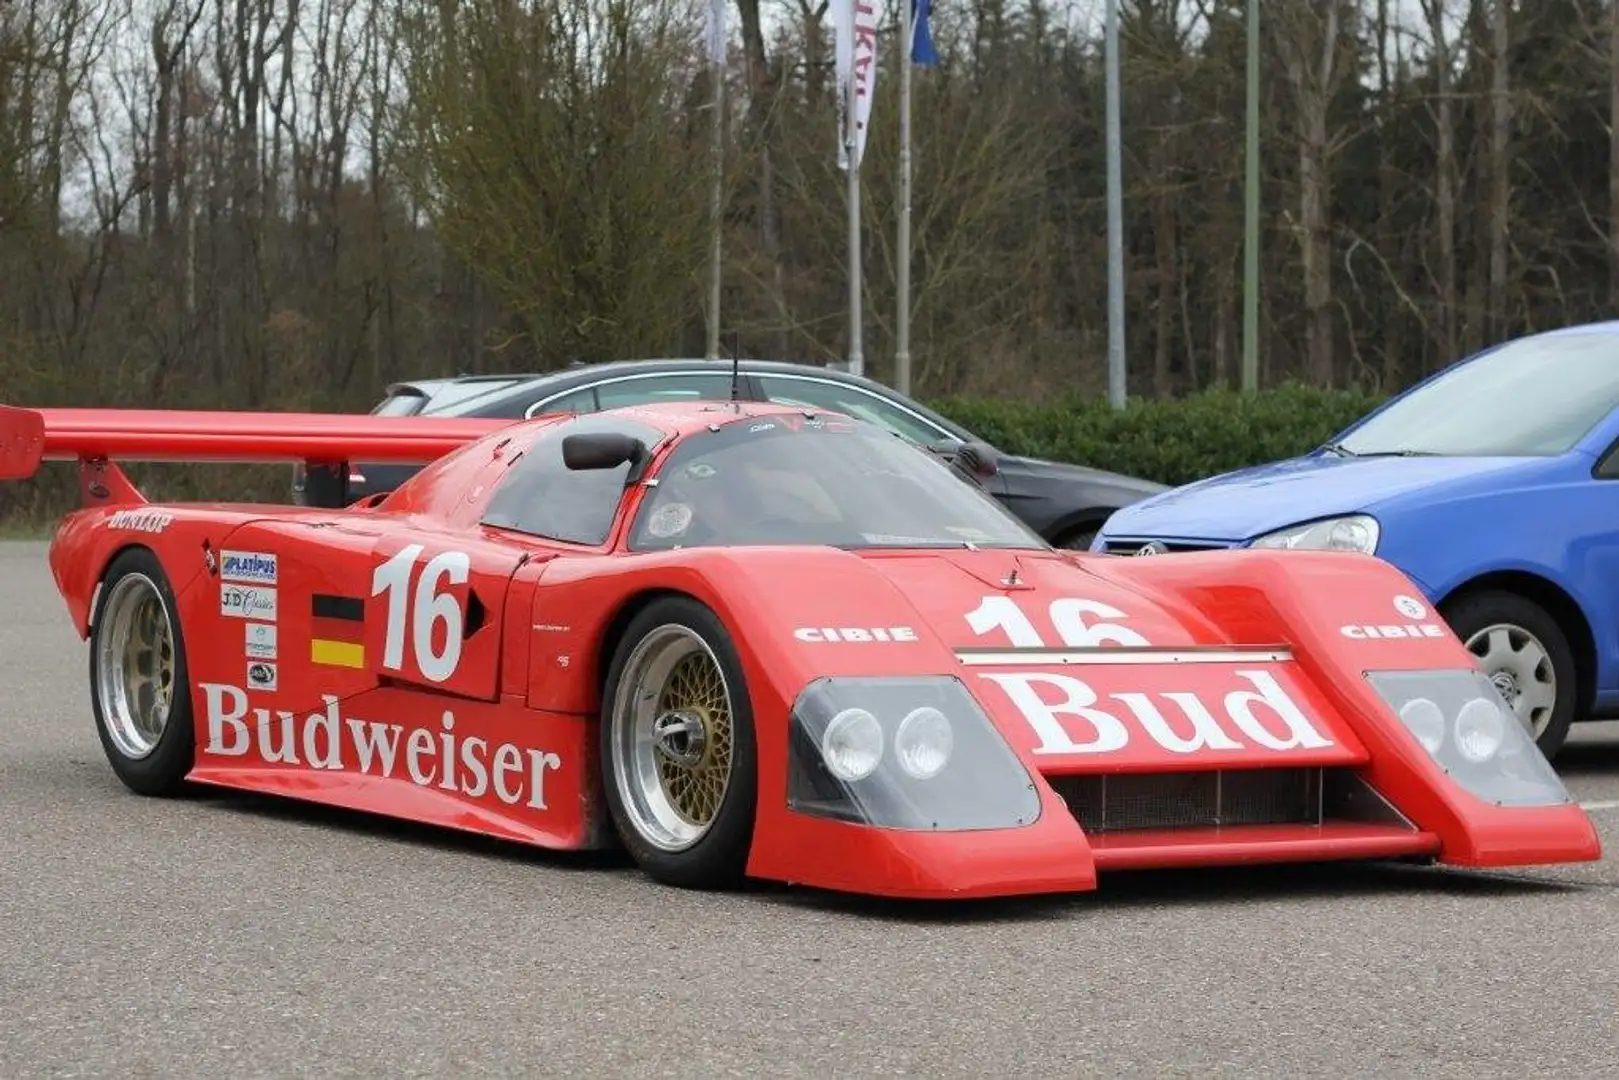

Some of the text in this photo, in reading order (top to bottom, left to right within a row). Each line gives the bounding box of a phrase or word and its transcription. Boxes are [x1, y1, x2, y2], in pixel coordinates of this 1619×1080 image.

[371, 544, 470, 682] 16
[794, 627, 919, 642] CIBIE
[1340, 624, 1445, 639] CIBIE
[198, 683, 561, 811] Budweiser
[977, 670, 1335, 755] Bud
